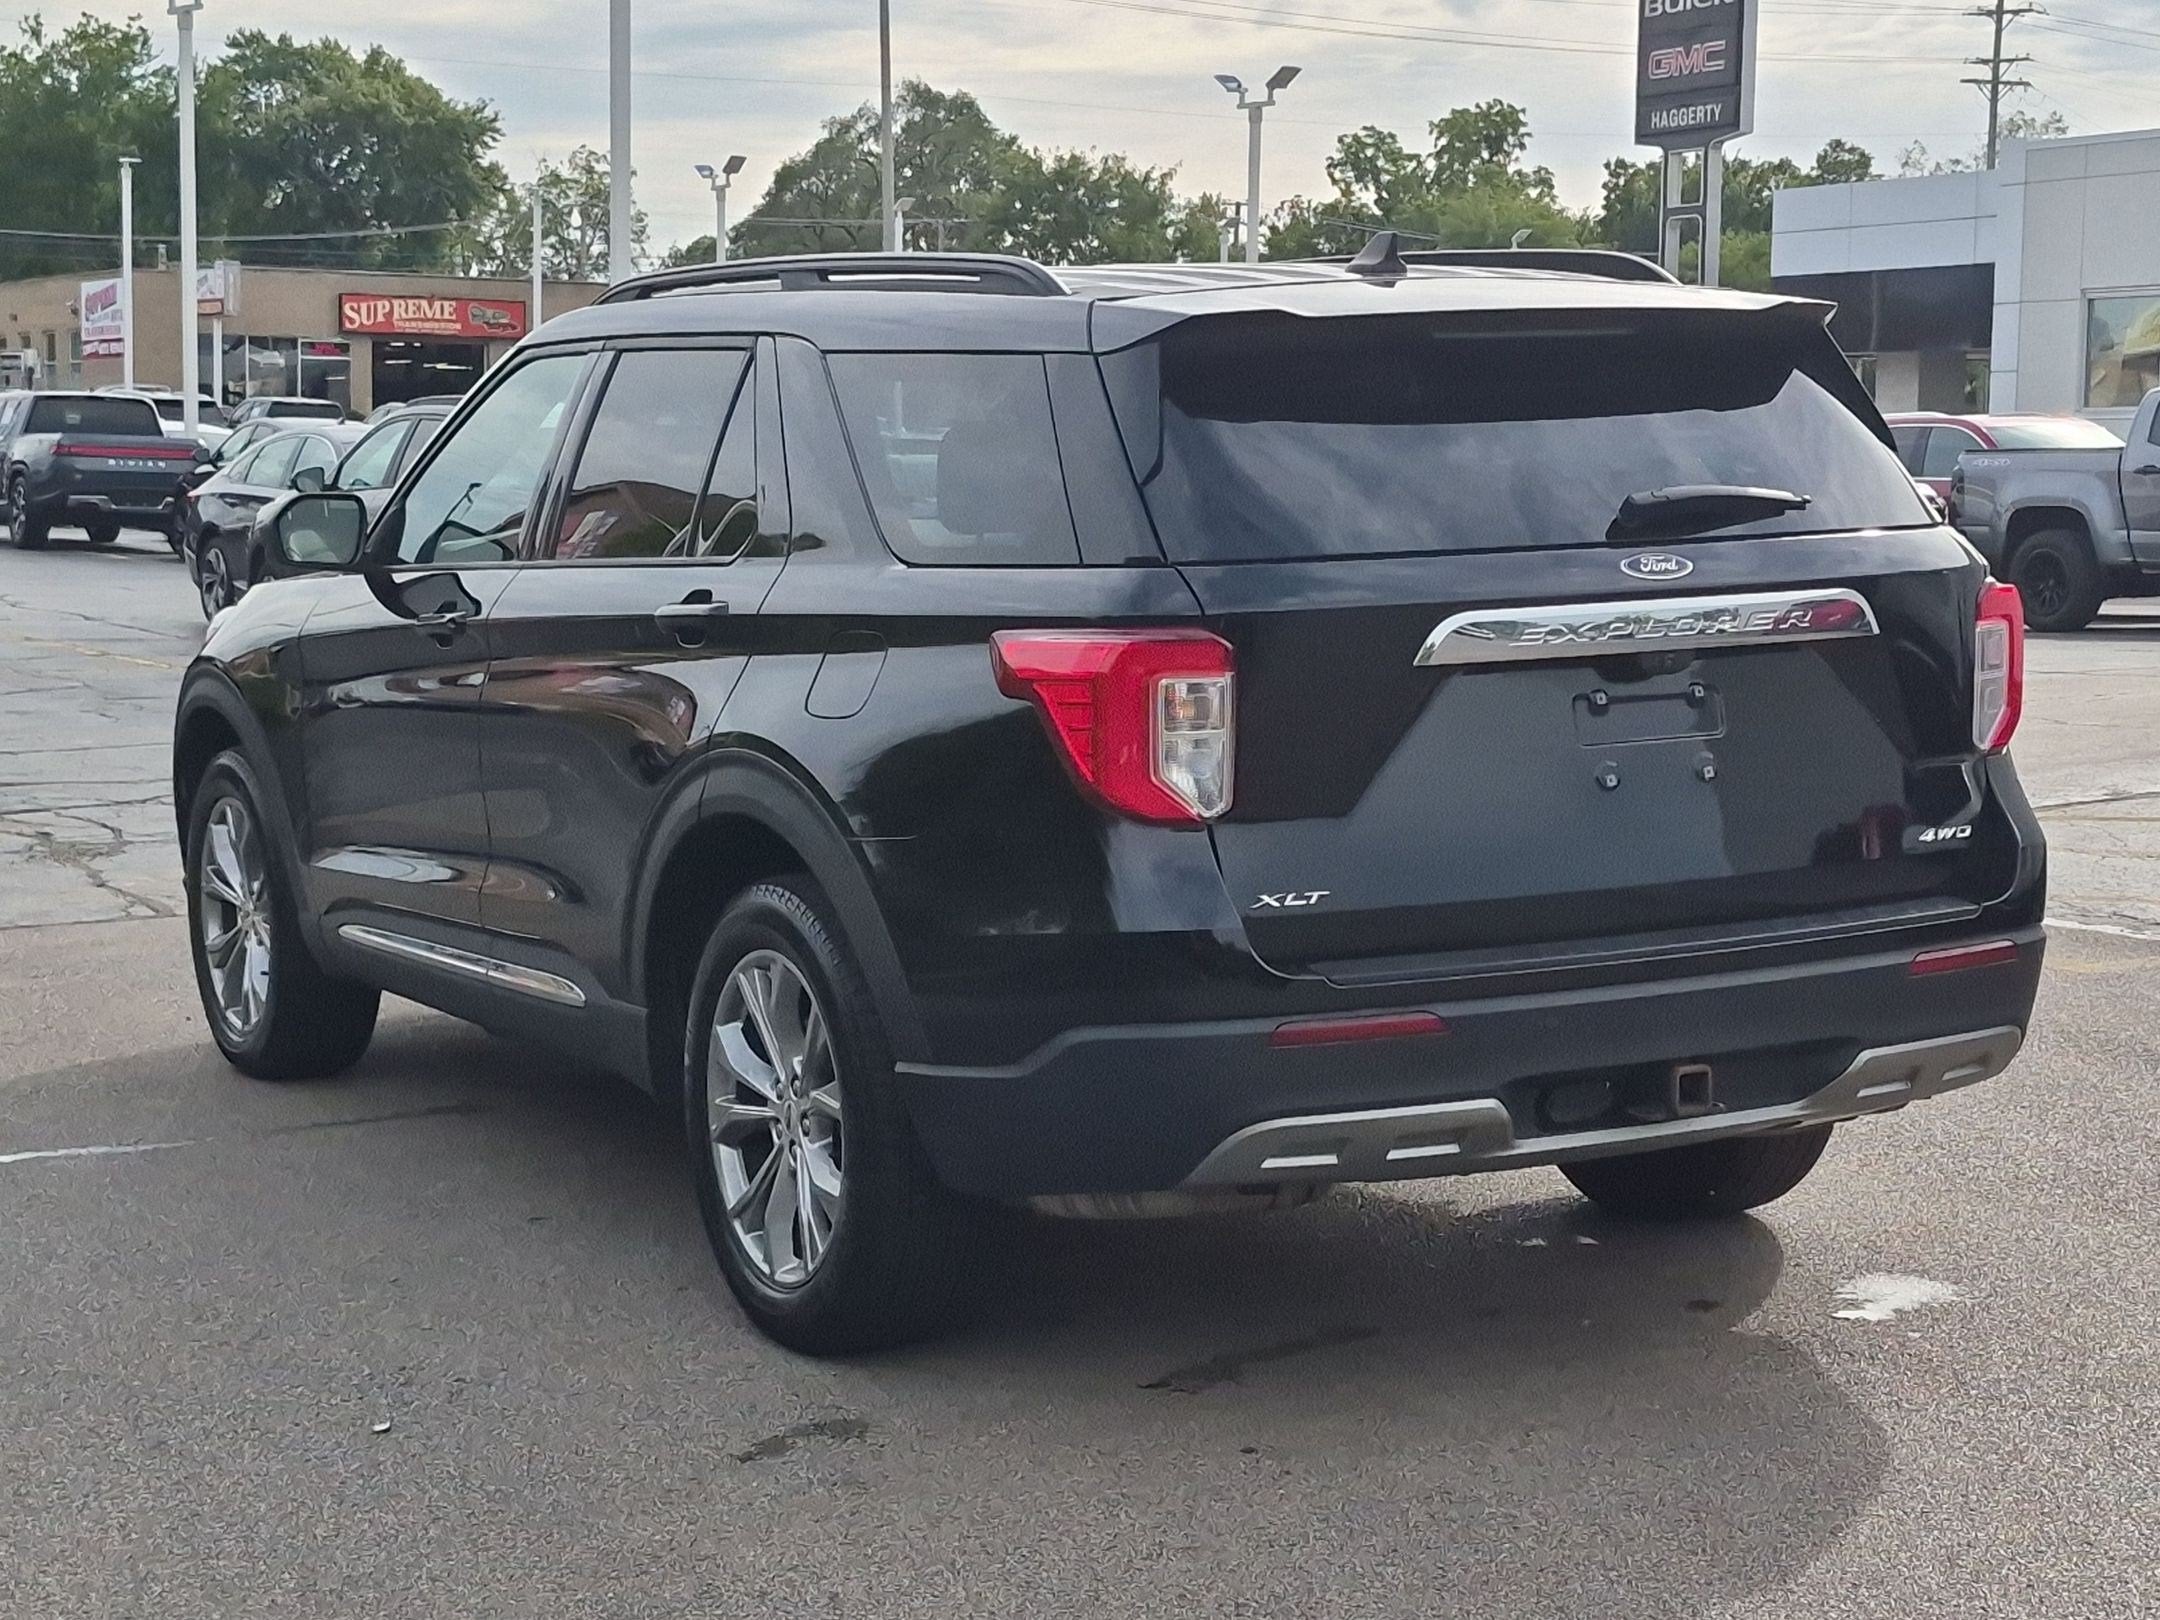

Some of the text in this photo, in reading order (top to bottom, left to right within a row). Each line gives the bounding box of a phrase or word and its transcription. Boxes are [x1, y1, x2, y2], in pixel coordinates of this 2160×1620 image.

[1648, 40, 1726, 79] GMC
[1651, 103, 1722, 129] HAGGERTY
[343, 300, 457, 329] SUPREME
[1640, 556, 1678, 572] Ford
[1509, 610, 1813, 646] EXPLORER
[1918, 825, 1972, 842] 4WD
[1249, 891, 1331, 909] XLT
